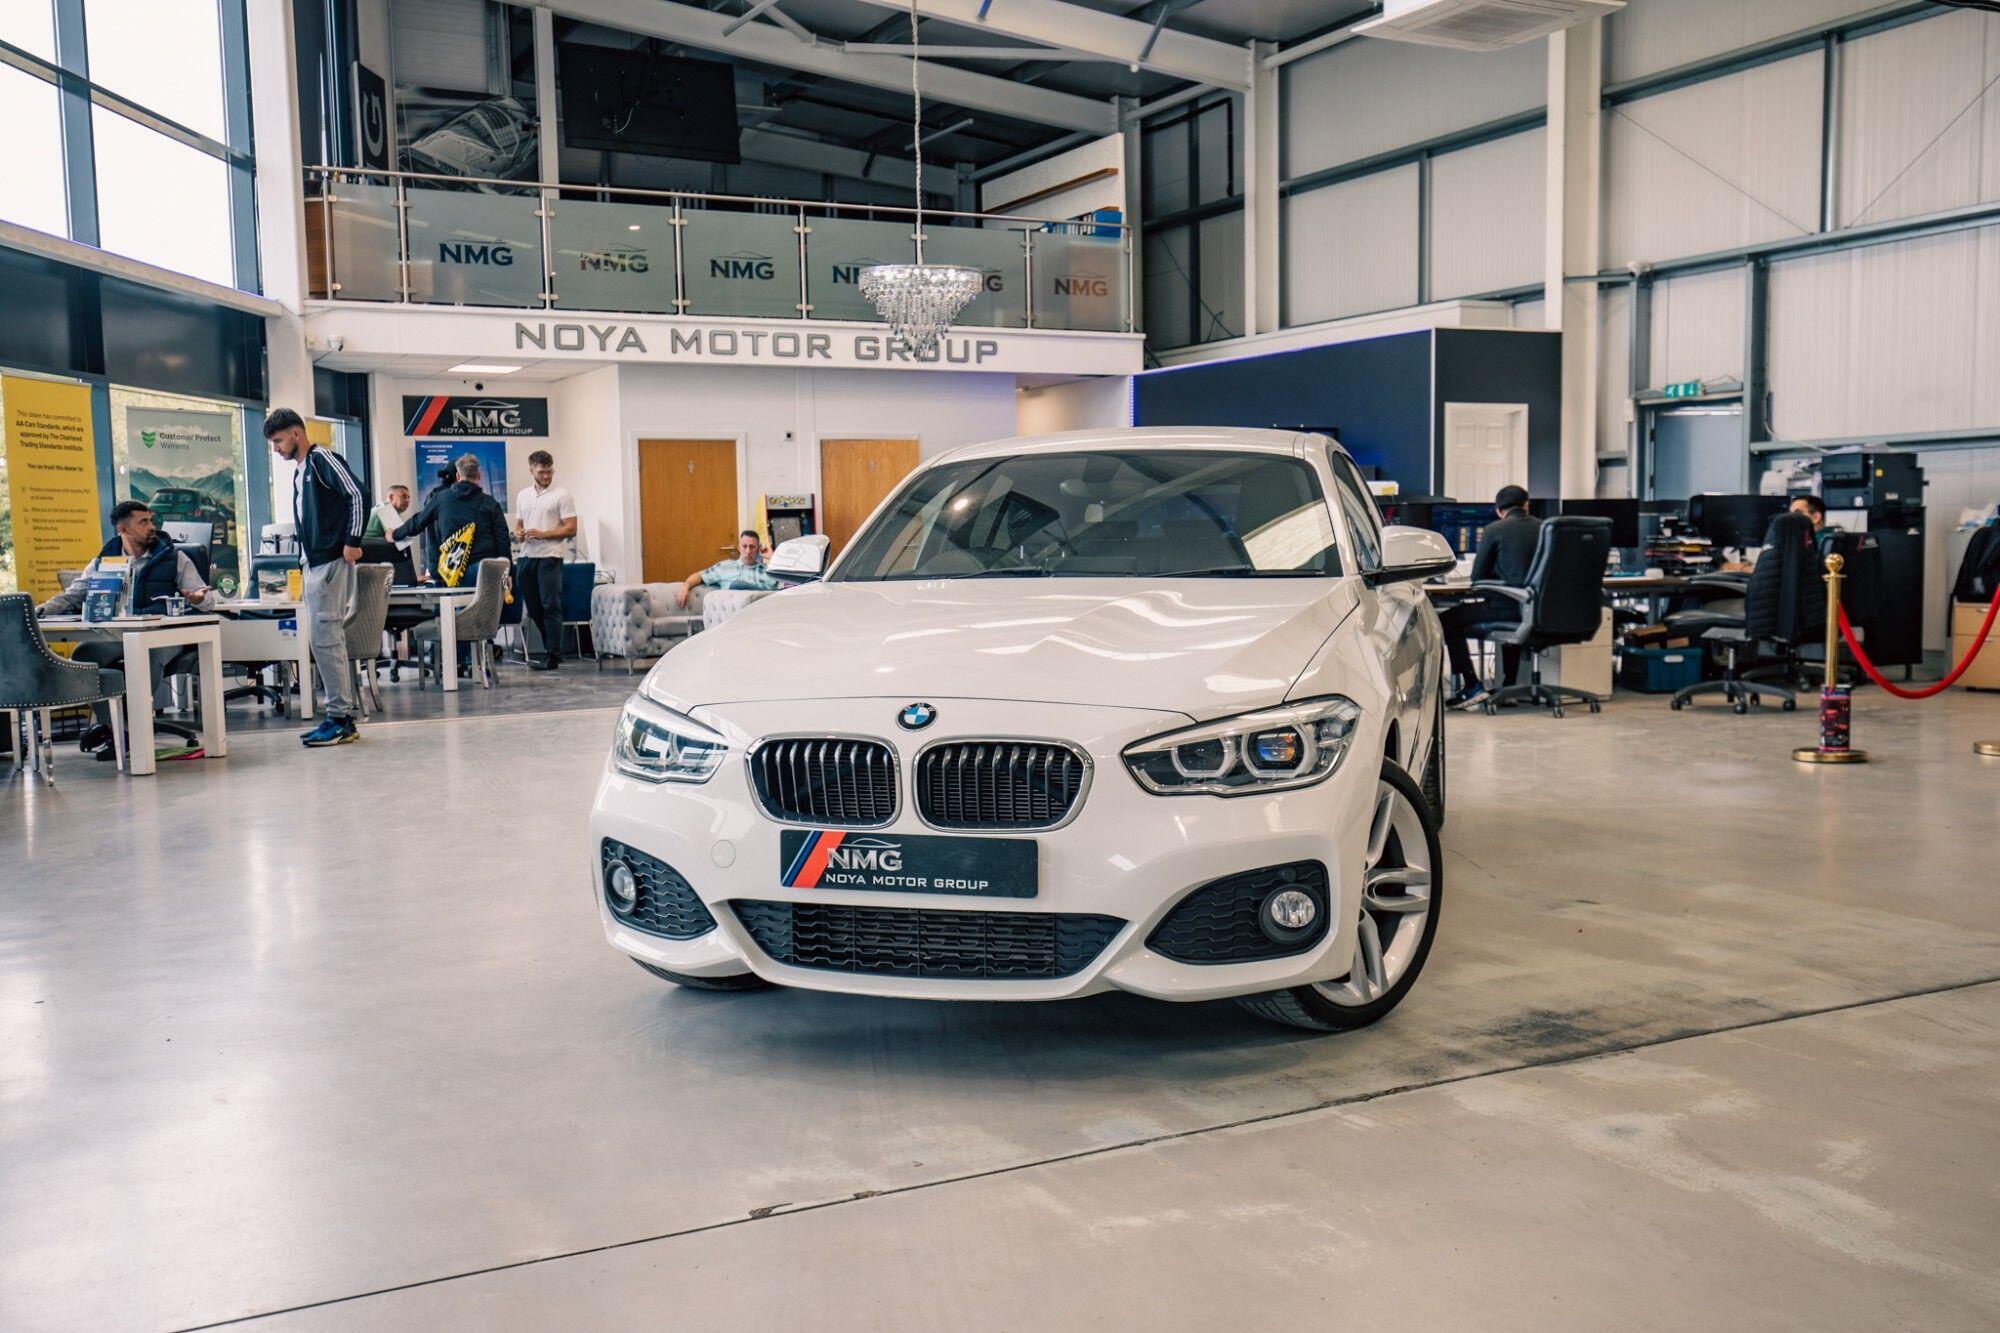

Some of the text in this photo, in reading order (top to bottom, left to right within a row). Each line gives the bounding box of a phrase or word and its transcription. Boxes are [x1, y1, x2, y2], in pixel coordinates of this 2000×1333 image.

[439, 243, 513, 266] NMG
[580, 252, 649, 273] NMG
[710, 259, 774, 280] NMG
[1054, 278, 1107, 297] NMG
[515, 322, 647, 353] NOYA
[670, 328, 832, 359] MOTOR
[451, 408, 521, 428] NMG
[19, 440, 38, 449] Trading
[39, 442, 62, 450] Standards
[159, 432, 221, 442] Customer Protect
[160, 442, 189, 450] Warranty
[827, 847, 903, 871] NMG
[825, 873, 989, 890] NOYA MOTOR GROUP
